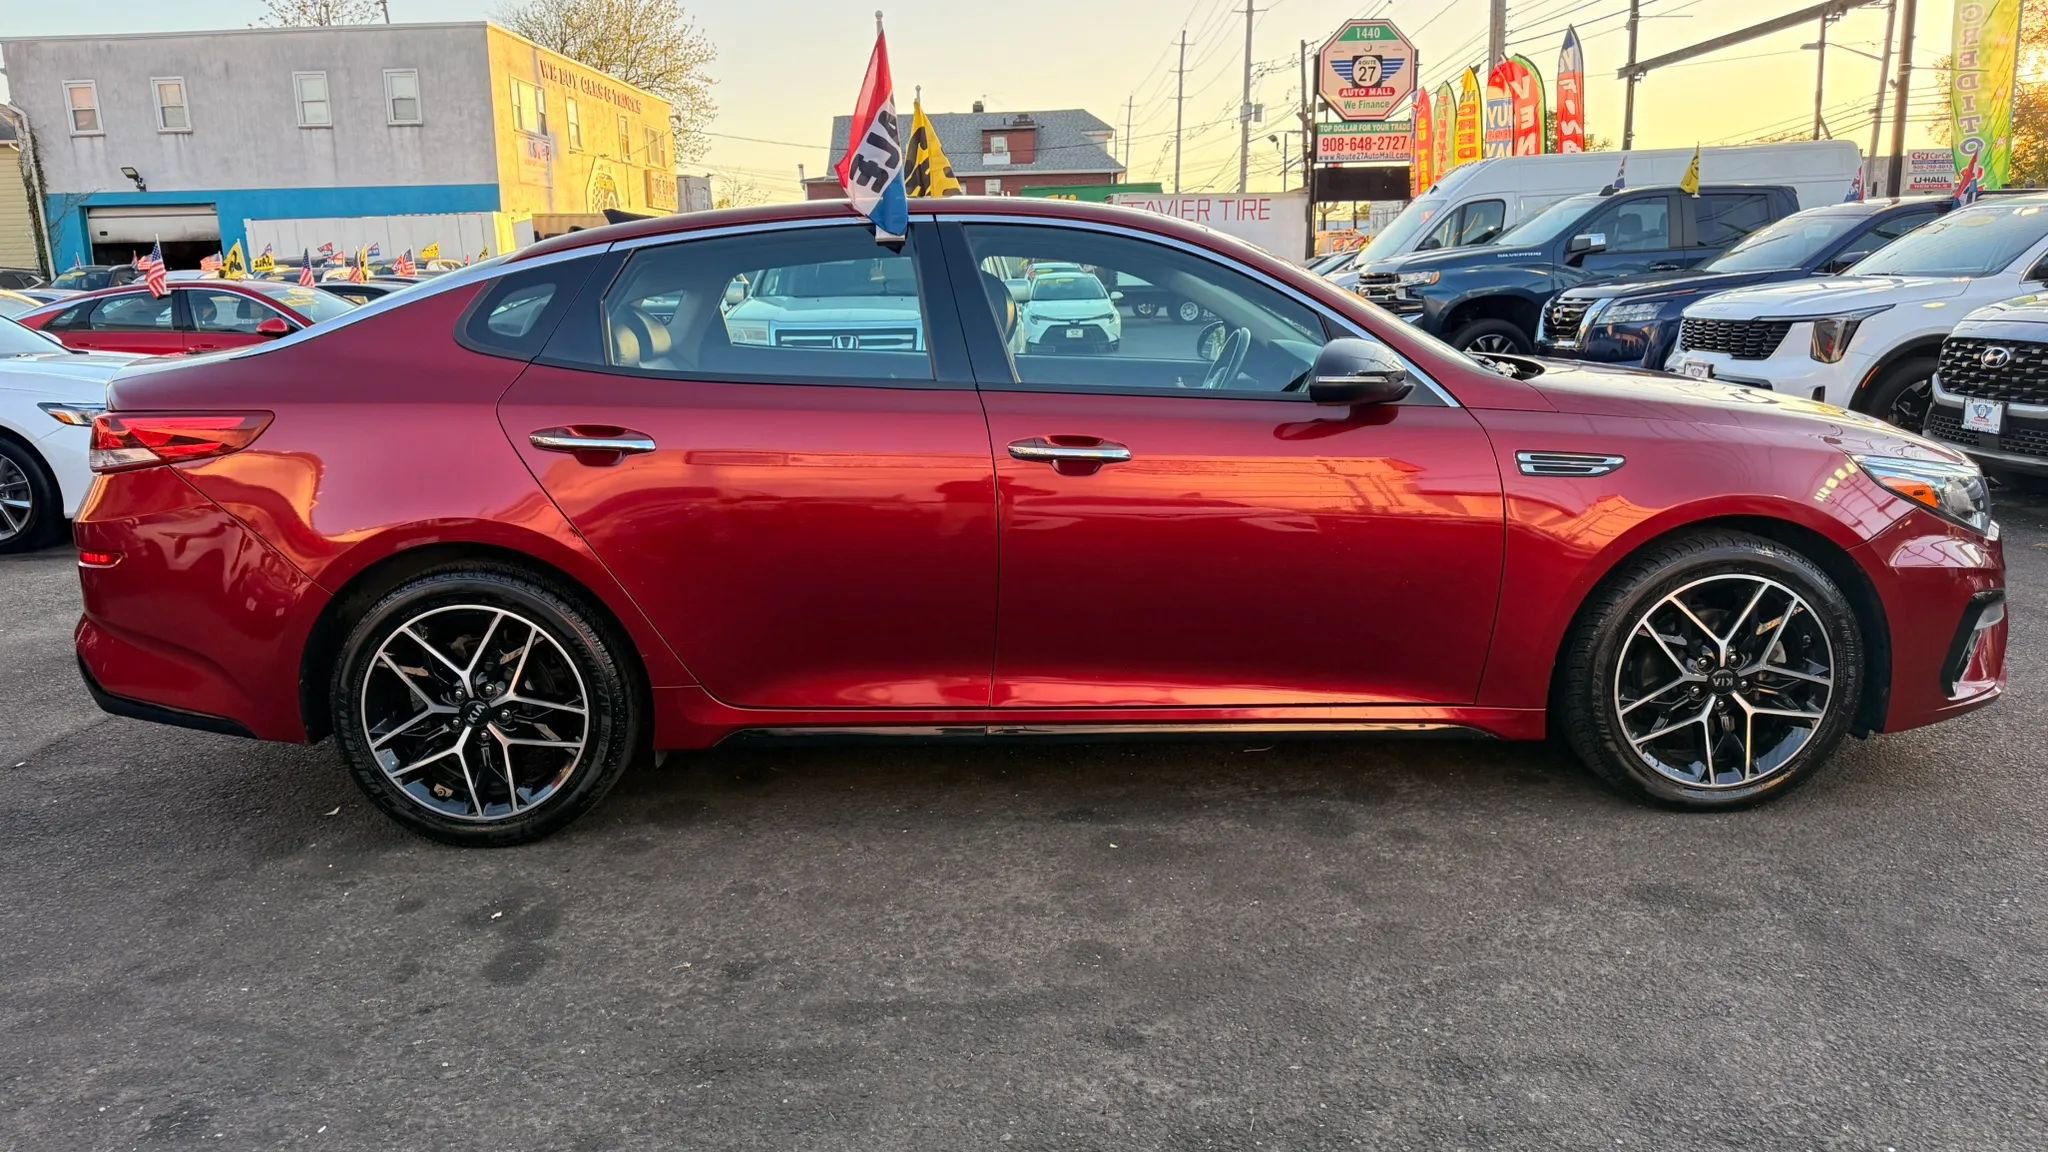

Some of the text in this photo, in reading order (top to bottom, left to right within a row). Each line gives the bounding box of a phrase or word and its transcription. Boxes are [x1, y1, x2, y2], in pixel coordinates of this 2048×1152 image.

[1356, 27, 1380, 39] 1440
[1358, 66, 1376, 82] 27
[1343, 99, 1391, 109] We Finance
[1333, 124, 1358, 132] DOLLAR
[1372, 123, 1390, 131] YOUR
[1321, 135, 1408, 152] 908-648-2727
[1217, 198, 1272, 221] TIRE
[1712, 677, 1734, 687] KIA
[467, 704, 485, 724] KIA
